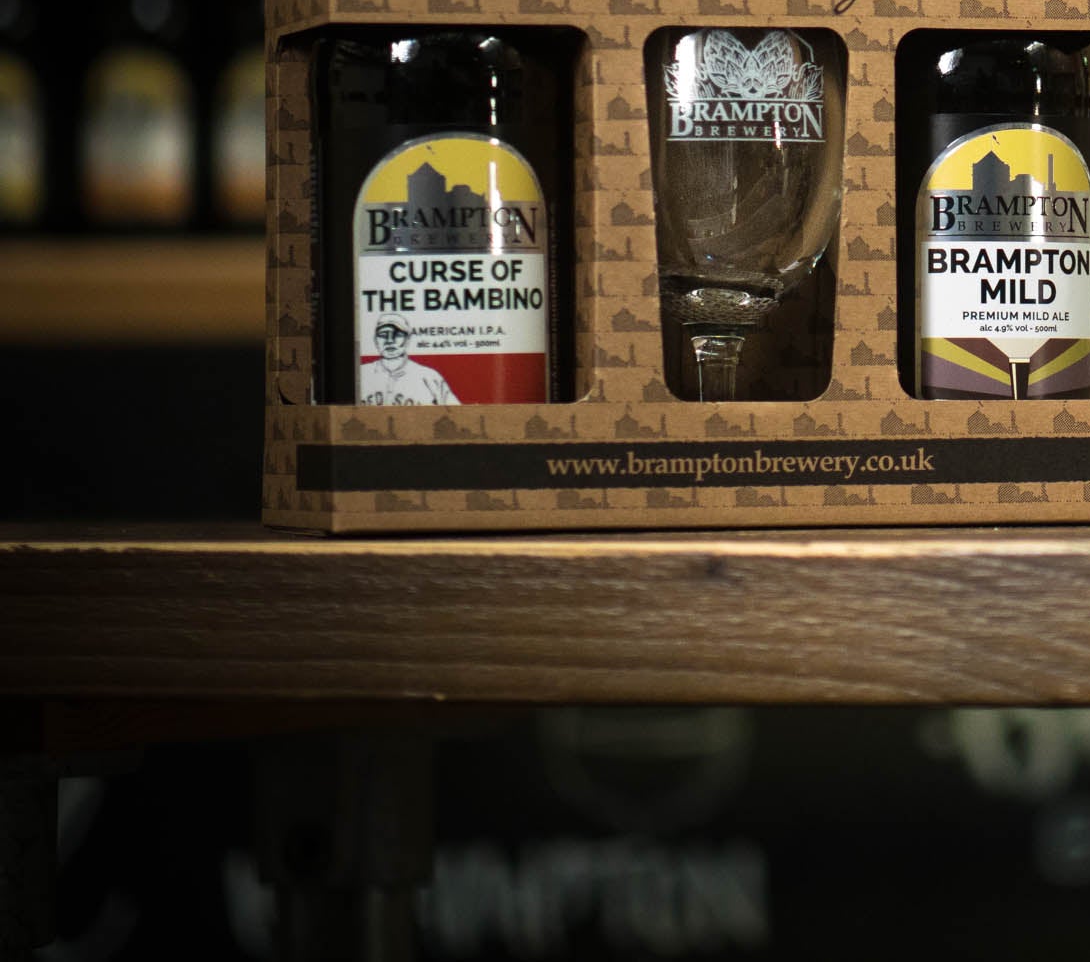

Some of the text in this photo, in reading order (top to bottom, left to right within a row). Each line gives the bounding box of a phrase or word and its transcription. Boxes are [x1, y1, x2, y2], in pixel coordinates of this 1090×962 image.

[669, 101, 823, 138] BRAMPTON
[694, 125, 801, 138] BREWERY
[931, 194, 1089, 234] BRAMPTON
[366, 206, 539, 247] BRAMPTON
[957, 221, 1069, 233] BREWERY
[389, 260, 523, 283] CURSE OF
[927, 248, 1090, 275] BRAMPTON
[362, 288, 543, 312] THE BAMBINO
[980, 278, 1057, 305] MILD
[962, 310, 1070, 321] PREMIUM MILD ALE
[410, 325, 506, 337] AMERICAN I.P.A.
[979, 324, 993, 332] alc
[994, 324, 1014, 333] 4.9%
[1015, 324, 1029, 332] vol
[546, 447, 936, 481] www.bramptonbrewery.co.uk
